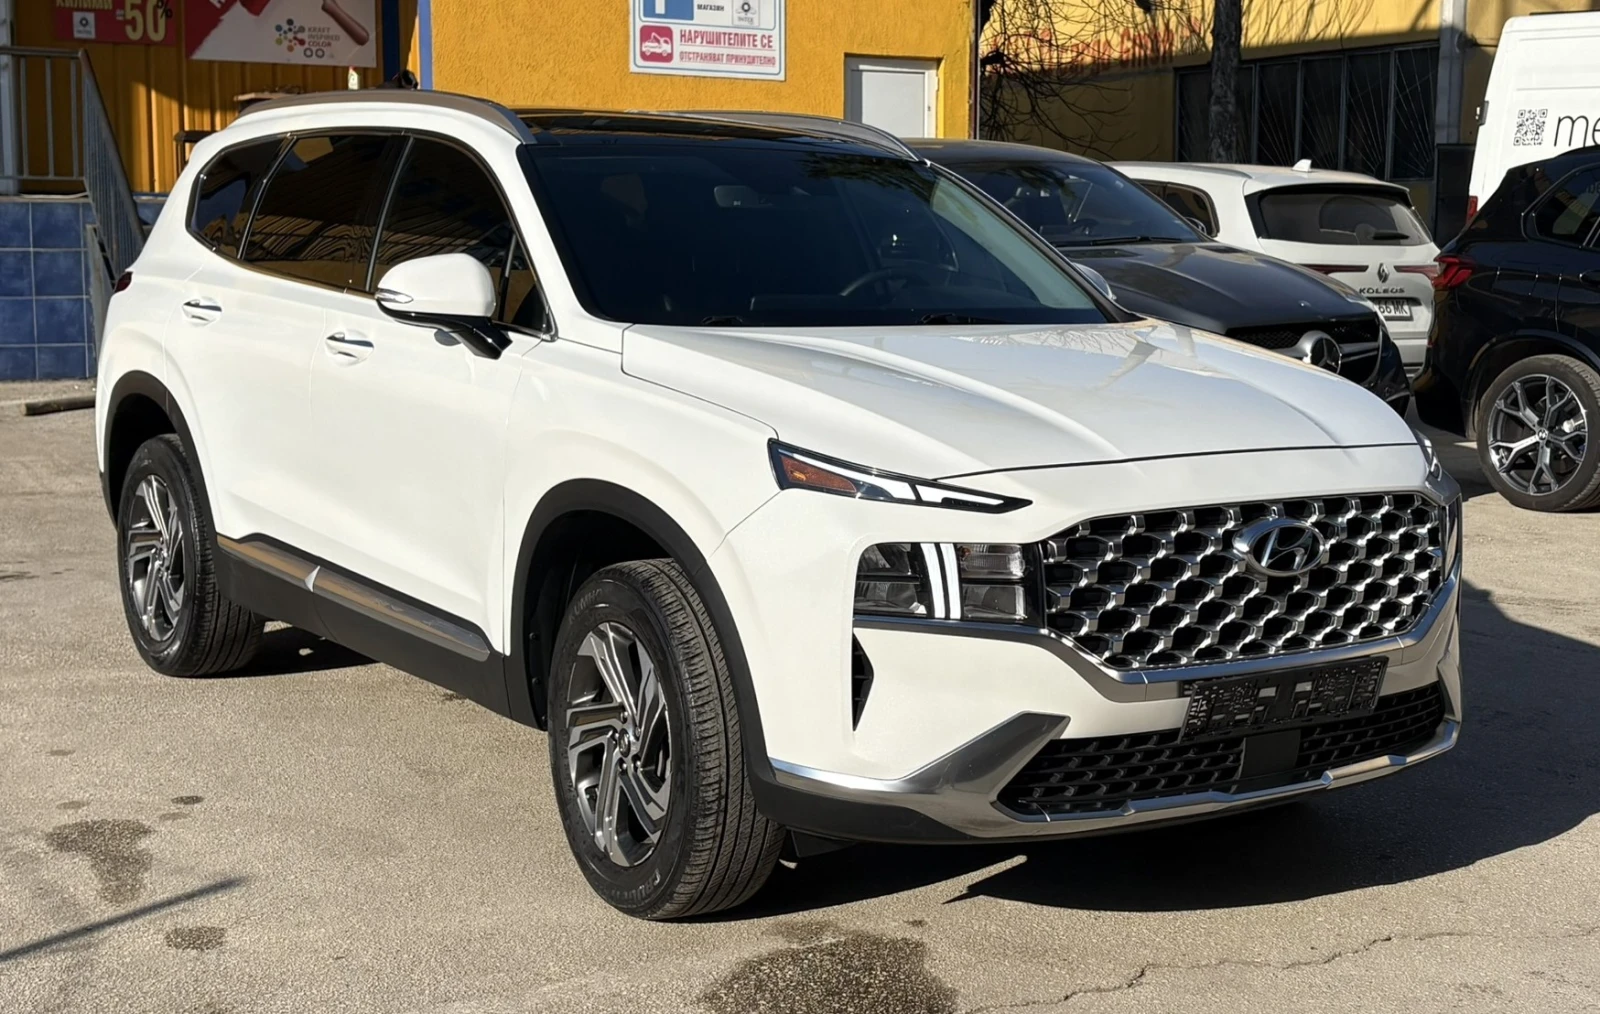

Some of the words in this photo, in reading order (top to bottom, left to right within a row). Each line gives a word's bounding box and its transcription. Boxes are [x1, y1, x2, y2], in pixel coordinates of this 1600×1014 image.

[697, 3, 725, 12] МАГАЗИН
[308, 33, 341, 41] INSPIRED
[679, 29, 758, 48] НАРУШИТЕЛИТЕ
[760, 34, 773, 49] СЕ
[679, 51, 724, 64] ОТСТРАНЯВАТ
[726, 53, 776, 66] ПРИНУДИТЕЛНО
[568, 587, 605, 626] KUMHO
